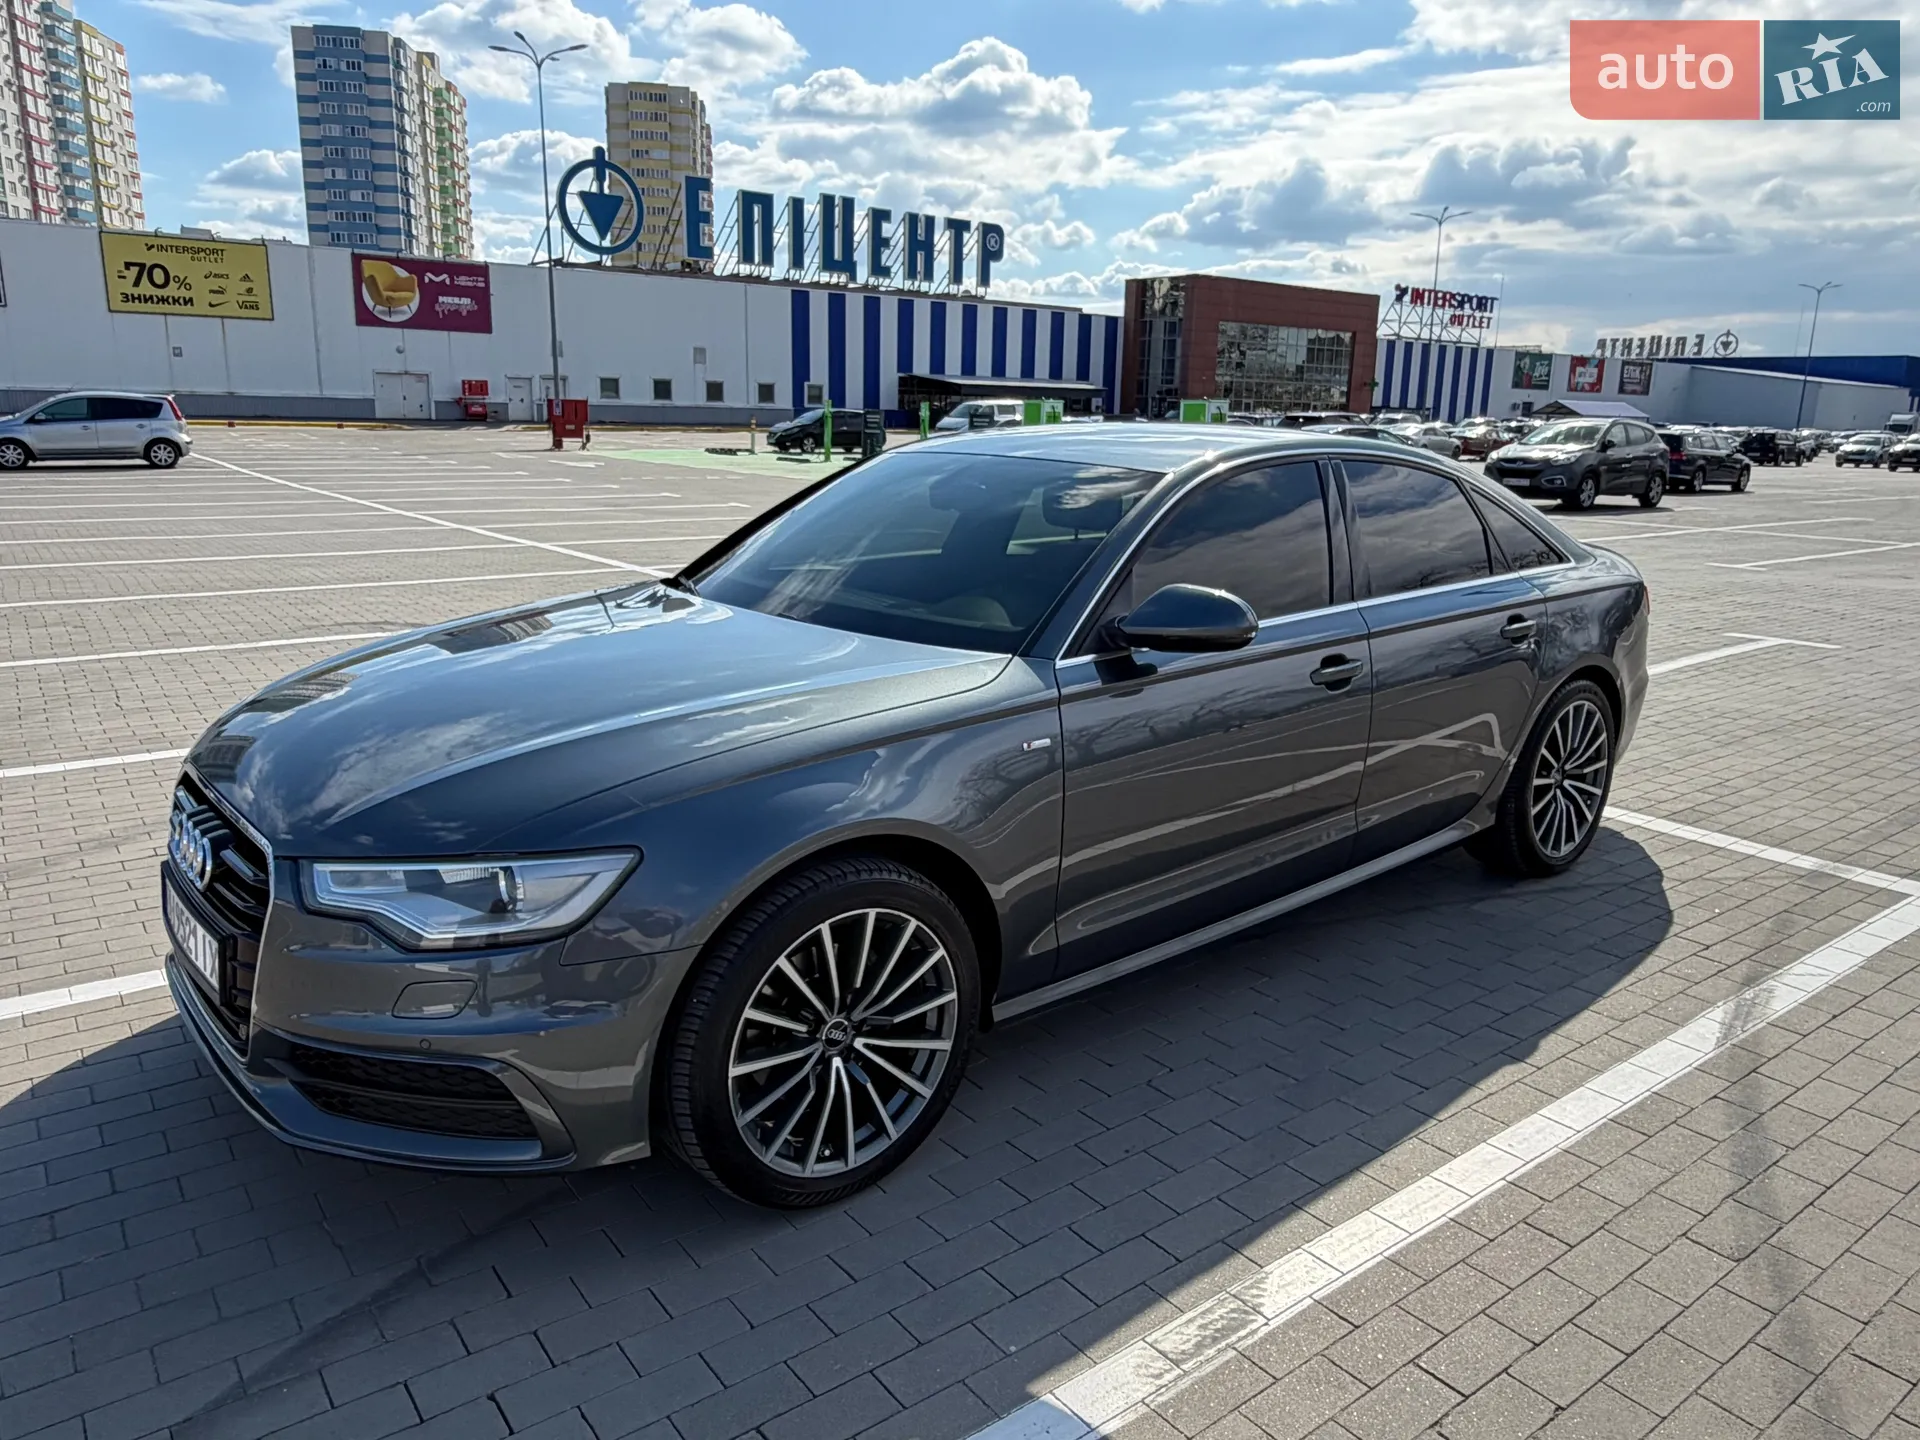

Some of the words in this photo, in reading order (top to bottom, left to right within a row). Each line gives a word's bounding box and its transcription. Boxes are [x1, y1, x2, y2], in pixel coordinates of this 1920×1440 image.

[685, 175, 1004, 288] ЕПІЦЕНТР
[156, 243, 226, 257] INTERSPORT
[190, 255, 224, 263] OUTLET
[119, 291, 194, 307] ЗНИЖКИ
[1410, 287, 1499, 314] INTERSPORT
[1449, 313, 1493, 329] OUTLET
